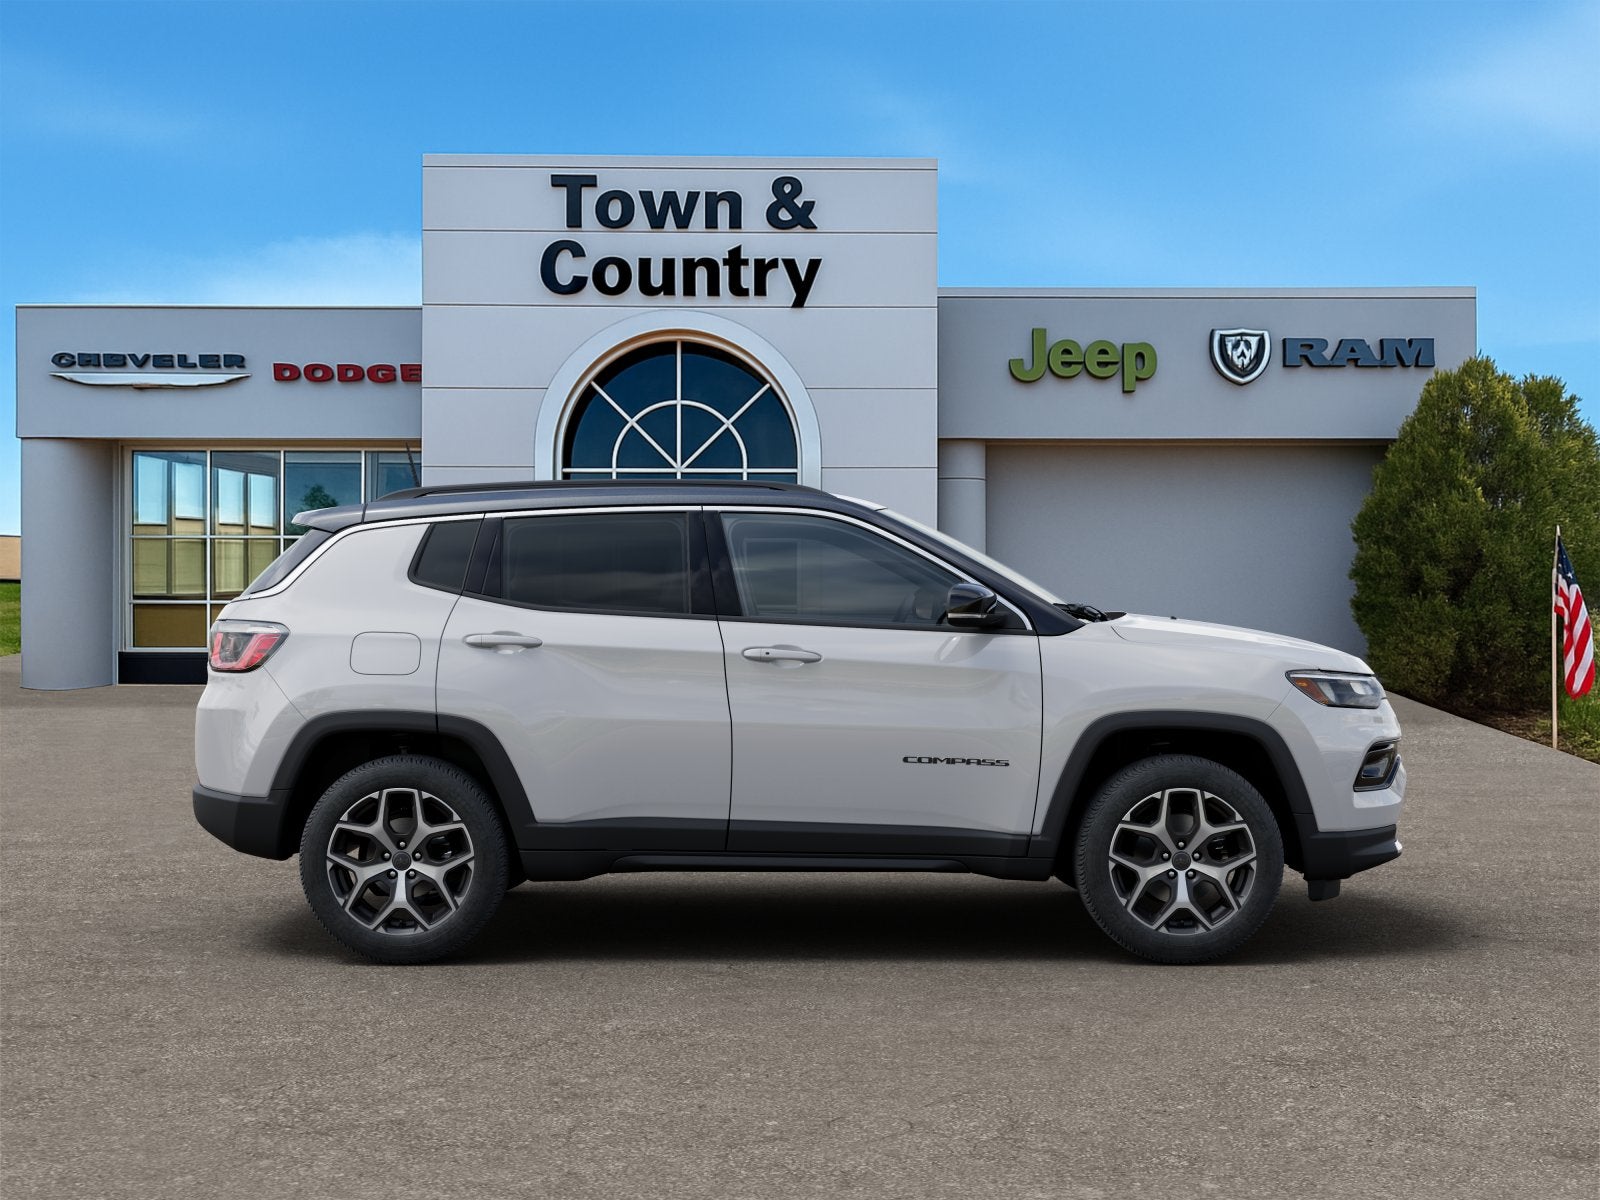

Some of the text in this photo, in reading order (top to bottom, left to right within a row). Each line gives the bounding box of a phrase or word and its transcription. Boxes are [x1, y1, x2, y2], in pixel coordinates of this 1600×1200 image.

[551, 174, 818, 230] Town &
[540, 239, 822, 308] Country
[273, 362, 422, 383] DODGE
[1008, 327, 1157, 393] Jeep
[1283, 337, 1435, 368] RAM
[902, 756, 1010, 767] COMPASS
